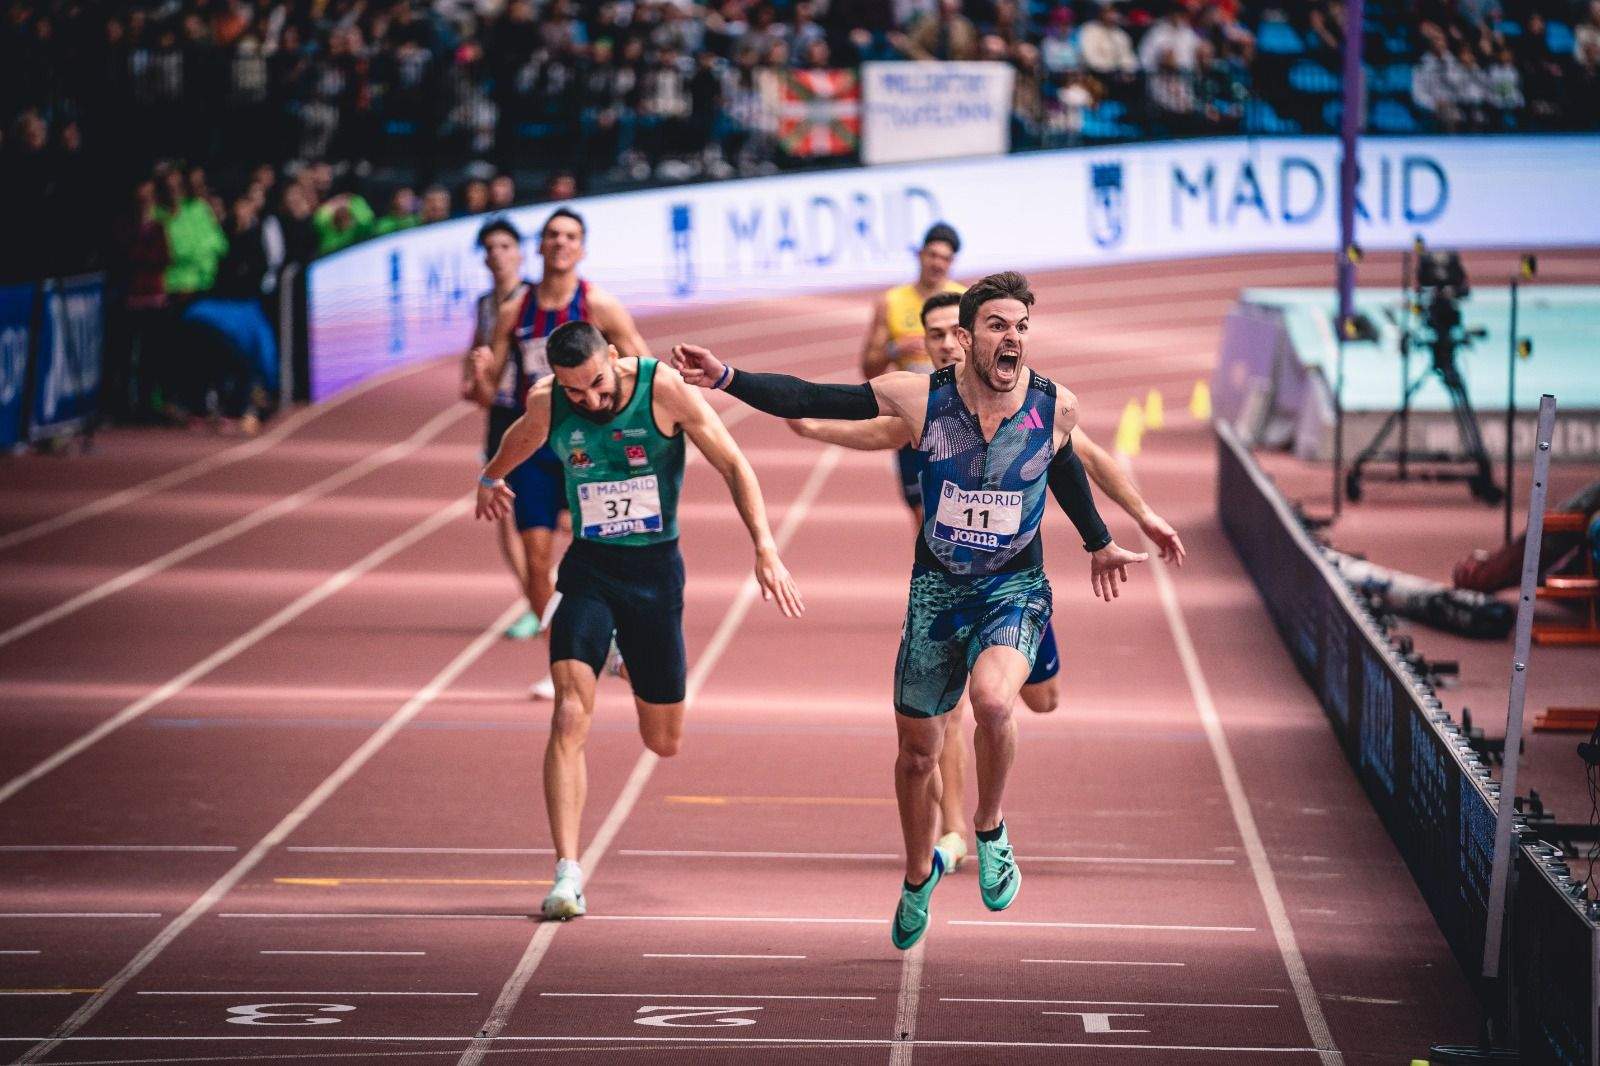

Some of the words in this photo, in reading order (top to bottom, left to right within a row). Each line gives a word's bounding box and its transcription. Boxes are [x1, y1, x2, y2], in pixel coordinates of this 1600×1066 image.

[596, 478, 656, 495] MADRID
[604, 498, 632, 519] 37
[957, 492, 1021, 507] MADRID
[963, 508, 990, 529] 11
[950, 527, 999, 548] Joma
[225, 1002, 358, 1026] 3
[633, 1005, 765, 1028] 2
[1041, 1011, 1152, 1033] 1
